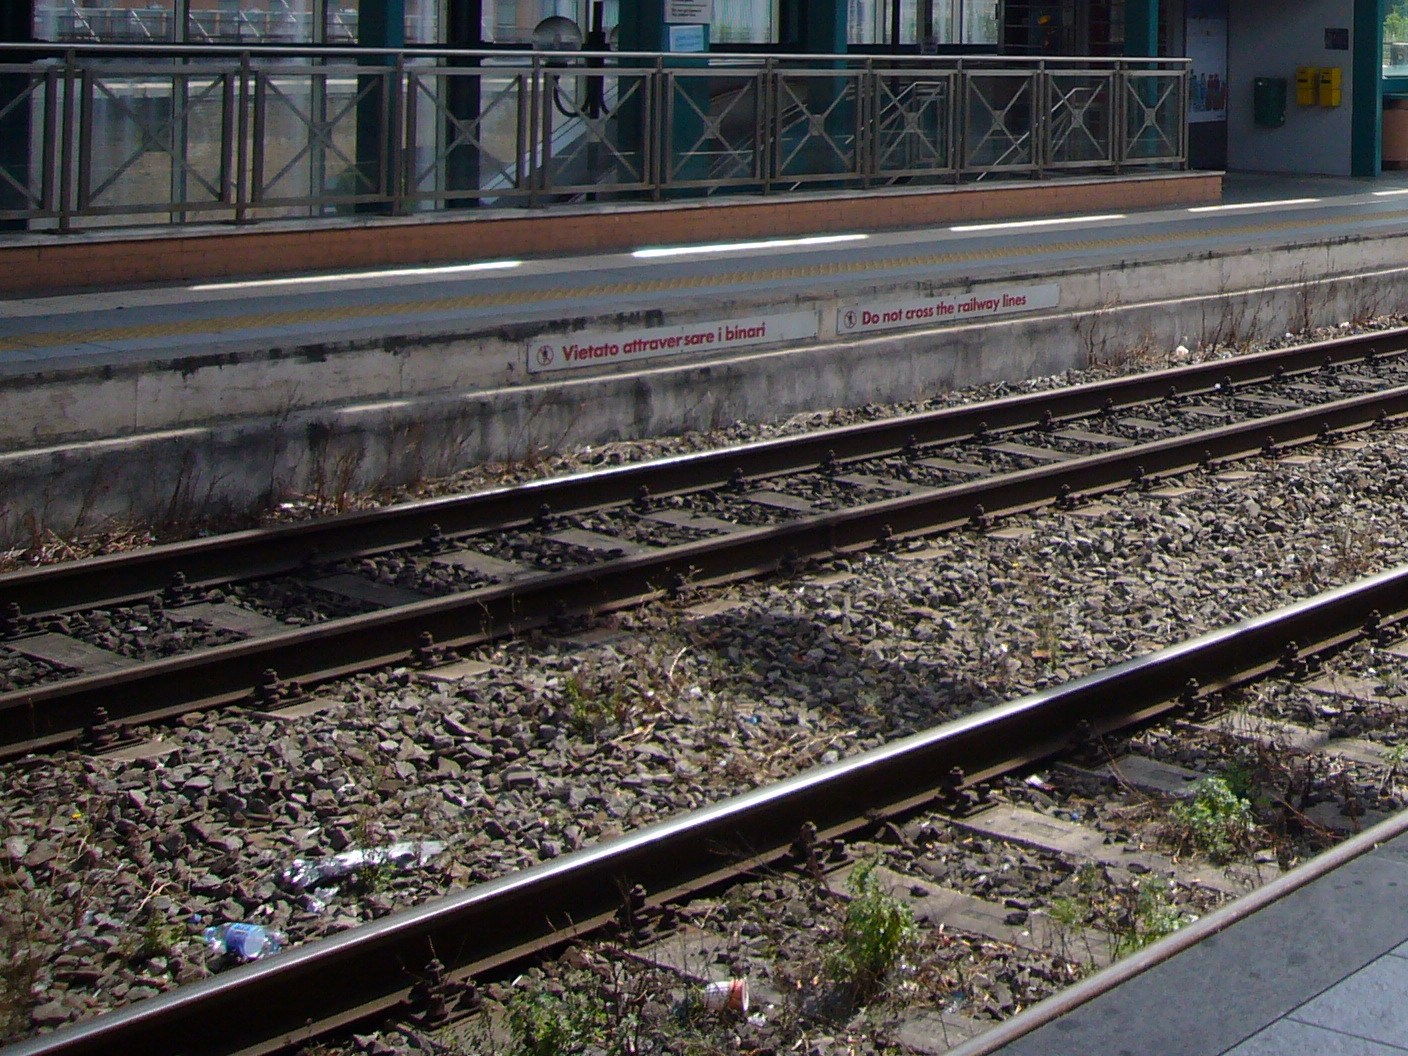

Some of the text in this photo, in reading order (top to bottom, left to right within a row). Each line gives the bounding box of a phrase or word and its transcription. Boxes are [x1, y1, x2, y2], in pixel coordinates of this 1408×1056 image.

[861, 294, 1027, 326] Do not cross the railway lines
[562, 322, 766, 362] Vietato attraversare i binari
